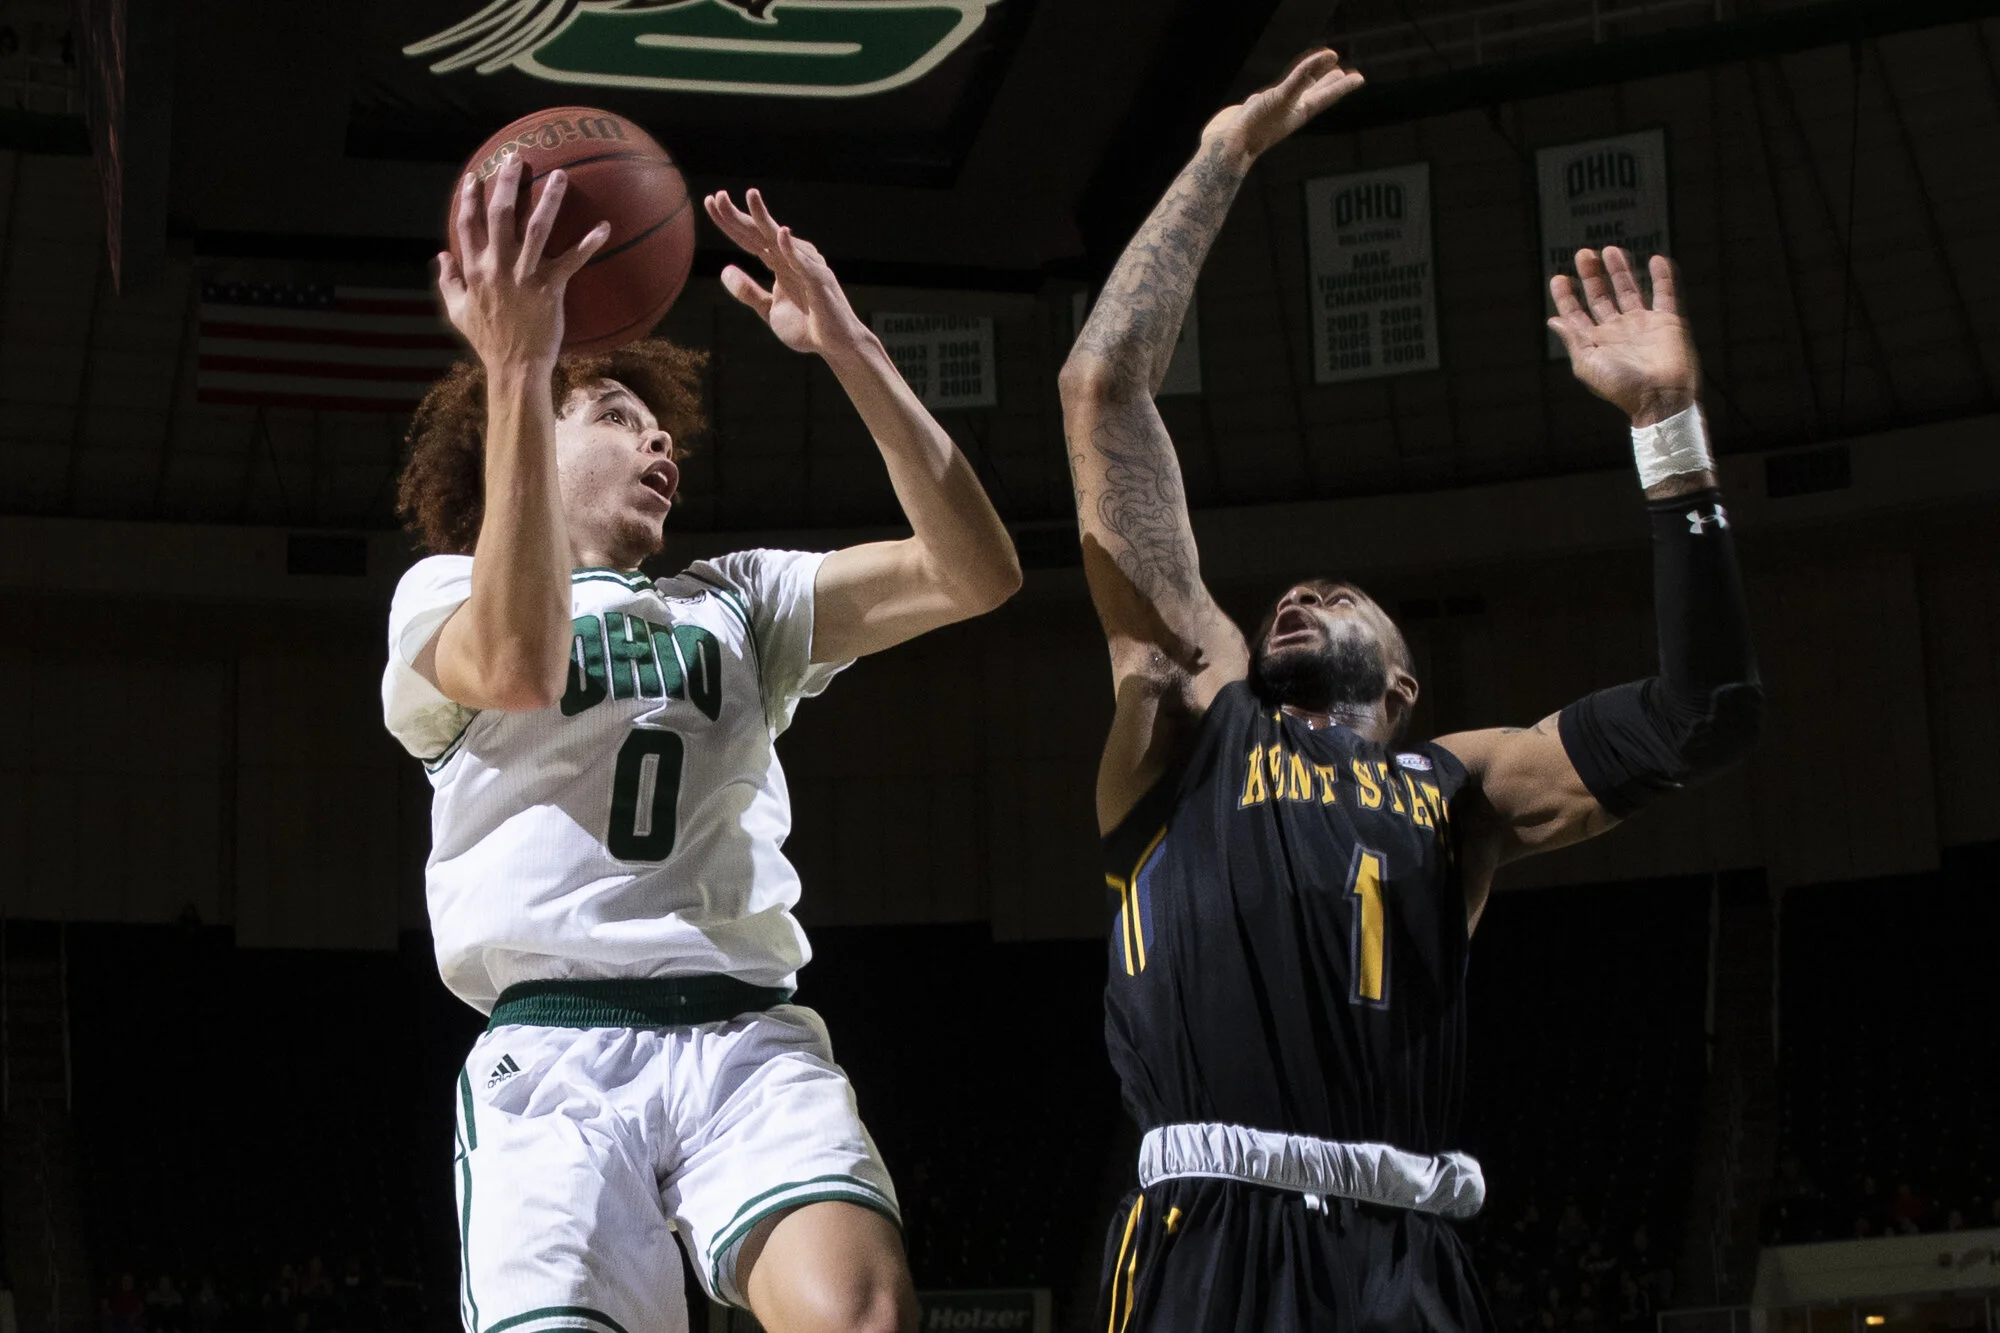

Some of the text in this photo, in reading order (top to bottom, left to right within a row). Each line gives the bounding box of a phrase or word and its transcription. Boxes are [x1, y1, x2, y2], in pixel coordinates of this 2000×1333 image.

[1566, 152, 1637, 200] OHIO
[1335, 182, 1403, 229] OHIO
[1586, 220, 1625, 241] MAC
[1352, 249, 1392, 269] MAC
[1318, 261, 1428, 293] TOURNAMENT
[1324, 281, 1423, 310] CHAMPIONS
[884, 315, 980, 334] CHAMPIONS
[1326, 306, 1423, 333] 2003 2004
[1381, 324, 1424, 345] 2006
[560, 610, 722, 722] OHIO
[1237, 742, 1338, 811] KENT
[605, 726, 685, 864] 0
[1343, 842, 1390, 1011] 1
[928, 1306, 1031, 1330] Holzer
